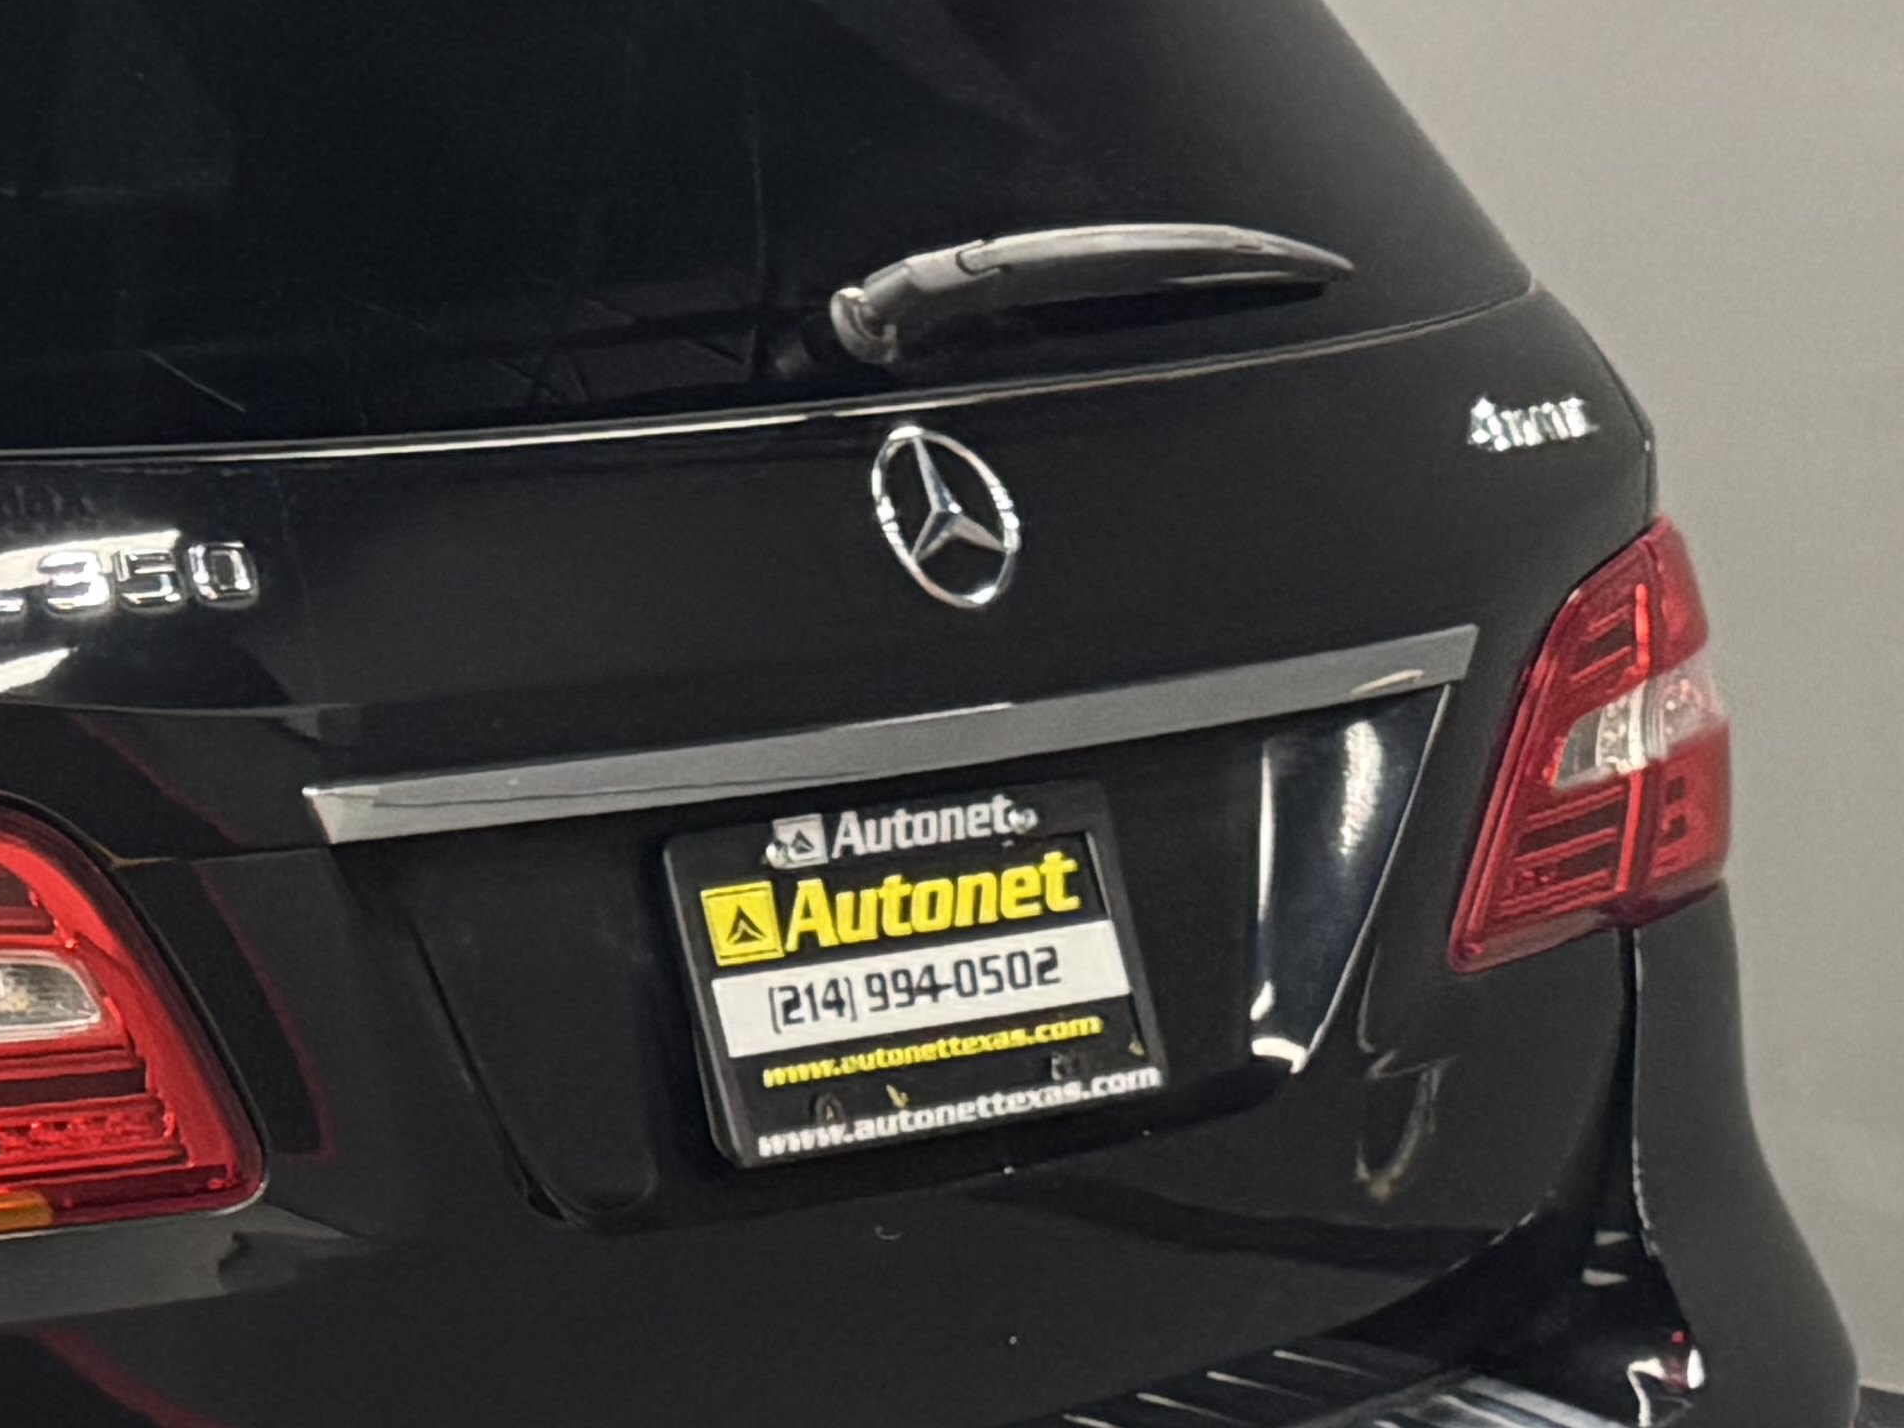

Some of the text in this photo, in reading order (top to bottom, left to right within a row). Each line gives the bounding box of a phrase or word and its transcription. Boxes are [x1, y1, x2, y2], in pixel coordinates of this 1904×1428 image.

[831, 793, 1015, 859] Autonet
[786, 851, 1081, 952] Autonet
[768, 946, 1061, 1034] (214) 994-0502
[763, 1015, 1104, 1089] www.autonettexas.com
[757, 1066, 1163, 1158] www.autonettexas.com
